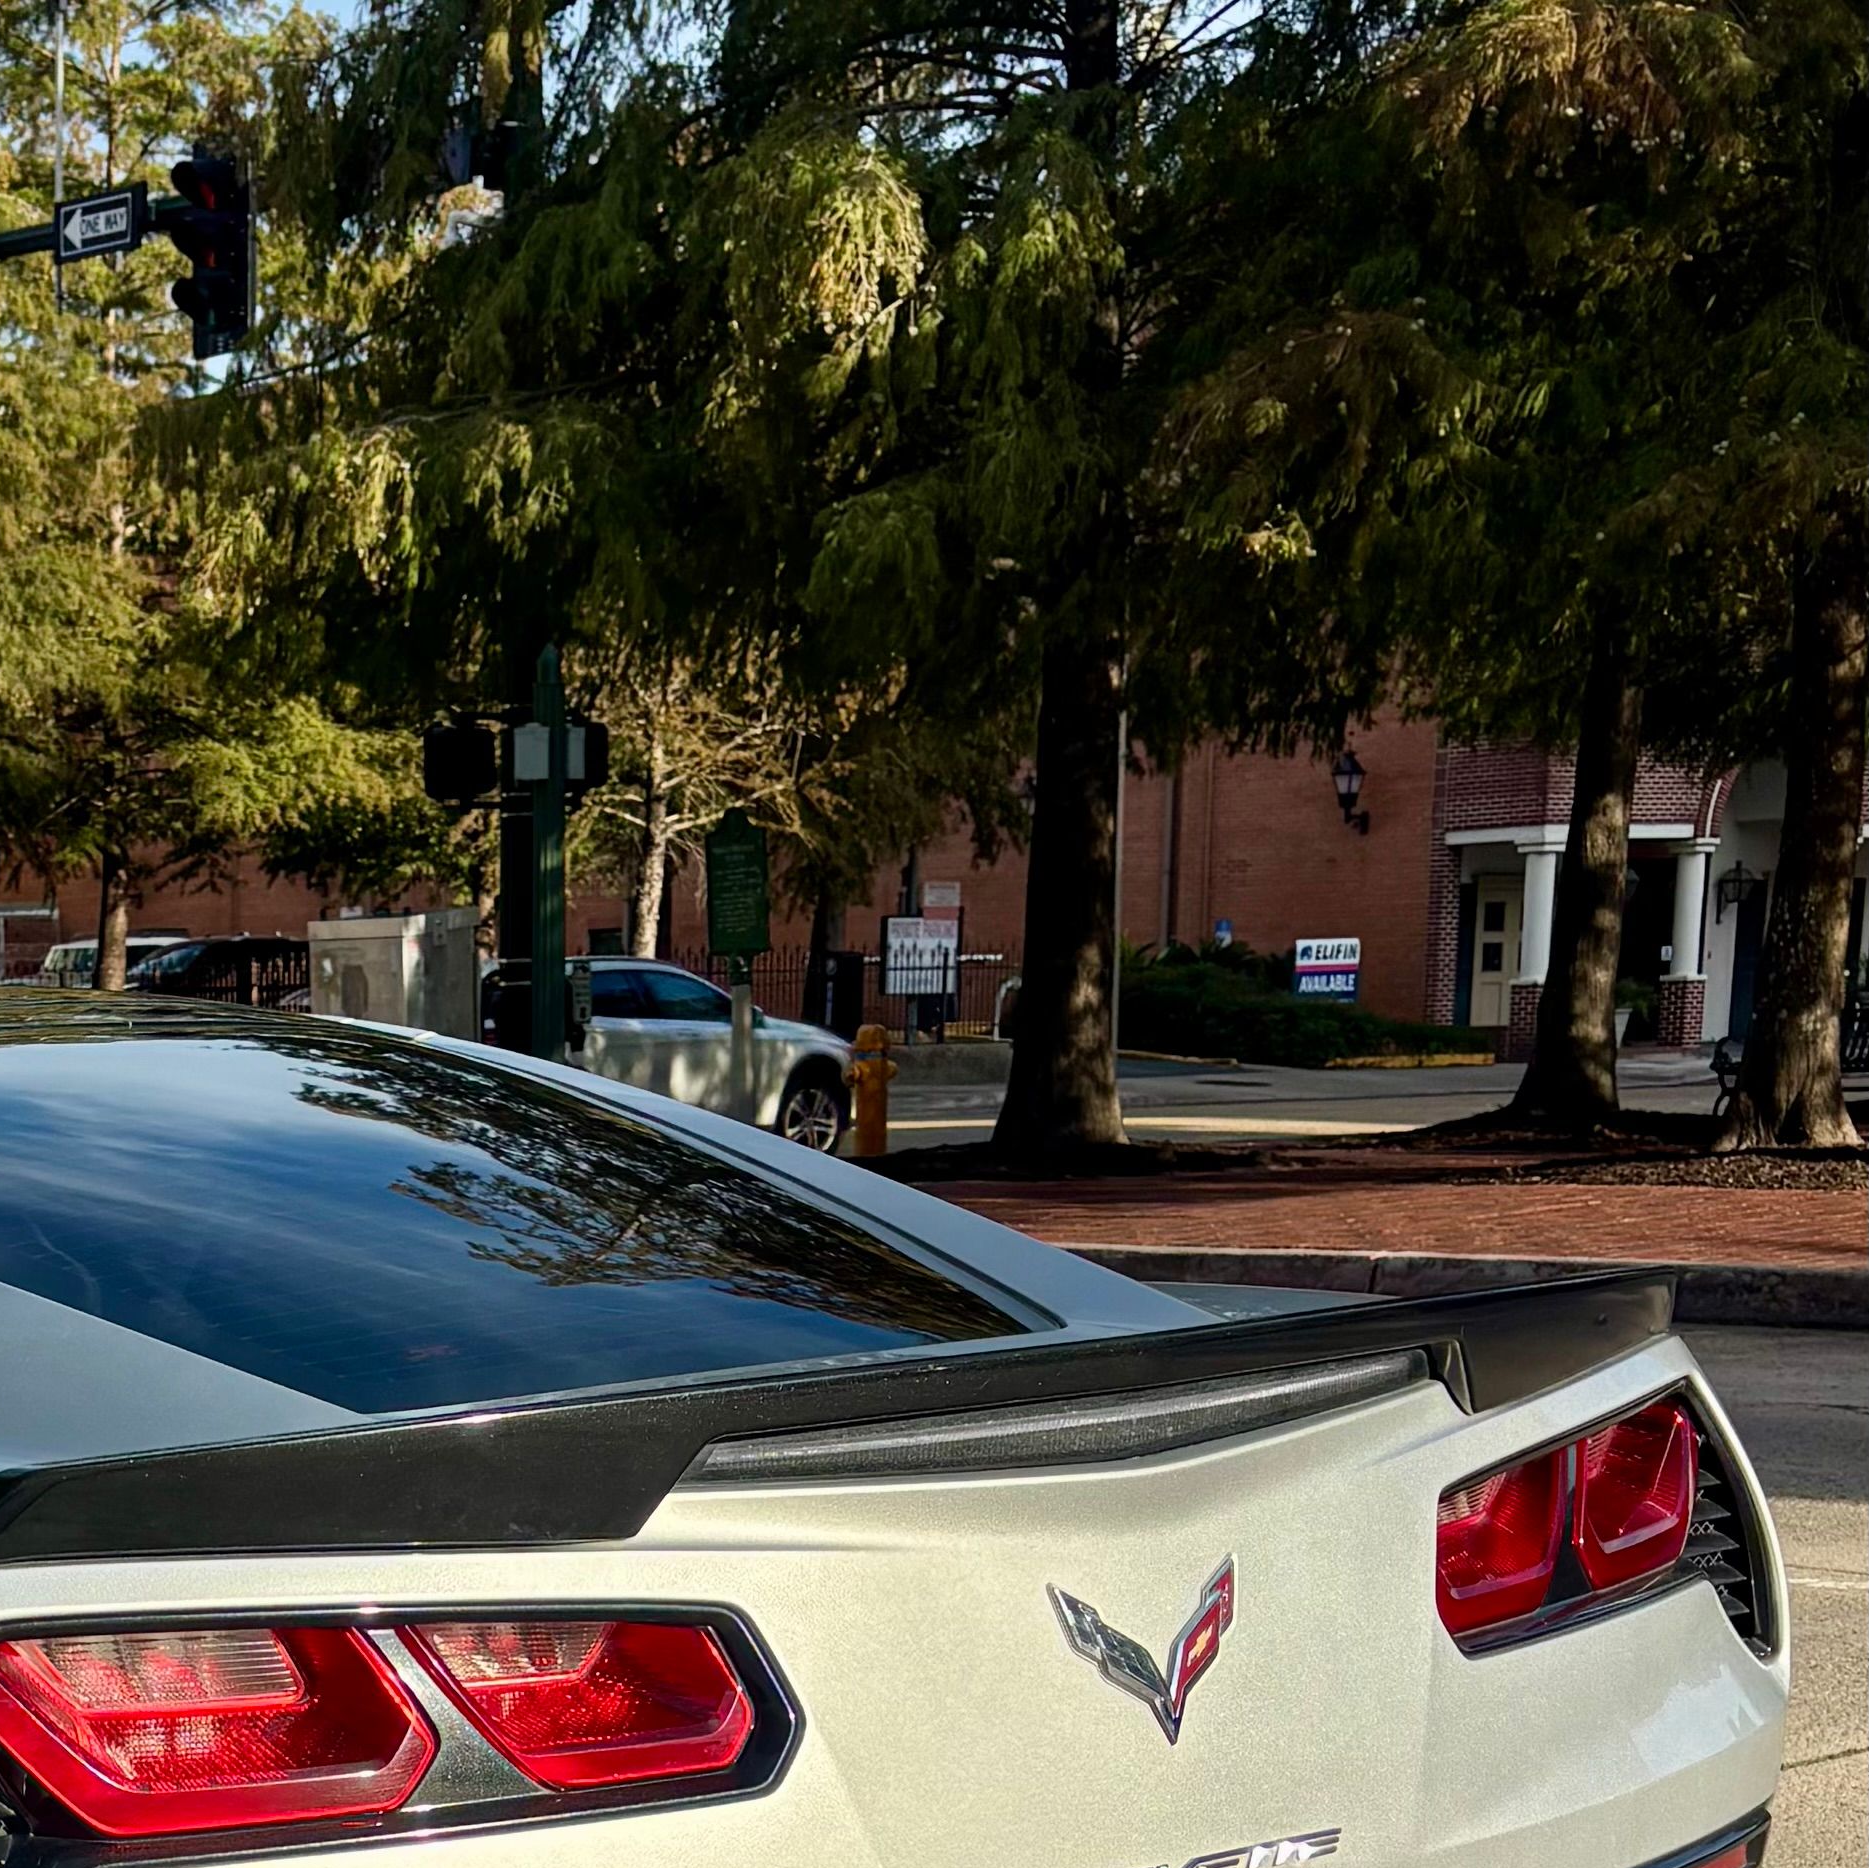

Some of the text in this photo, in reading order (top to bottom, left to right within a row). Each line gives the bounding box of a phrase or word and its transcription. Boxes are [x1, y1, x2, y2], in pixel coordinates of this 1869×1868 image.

[79, 211, 125, 235] ONE WAY
[1315, 944, 1358, 961] ELIFIN
[1298, 973, 1356, 993] AVAILABLE
